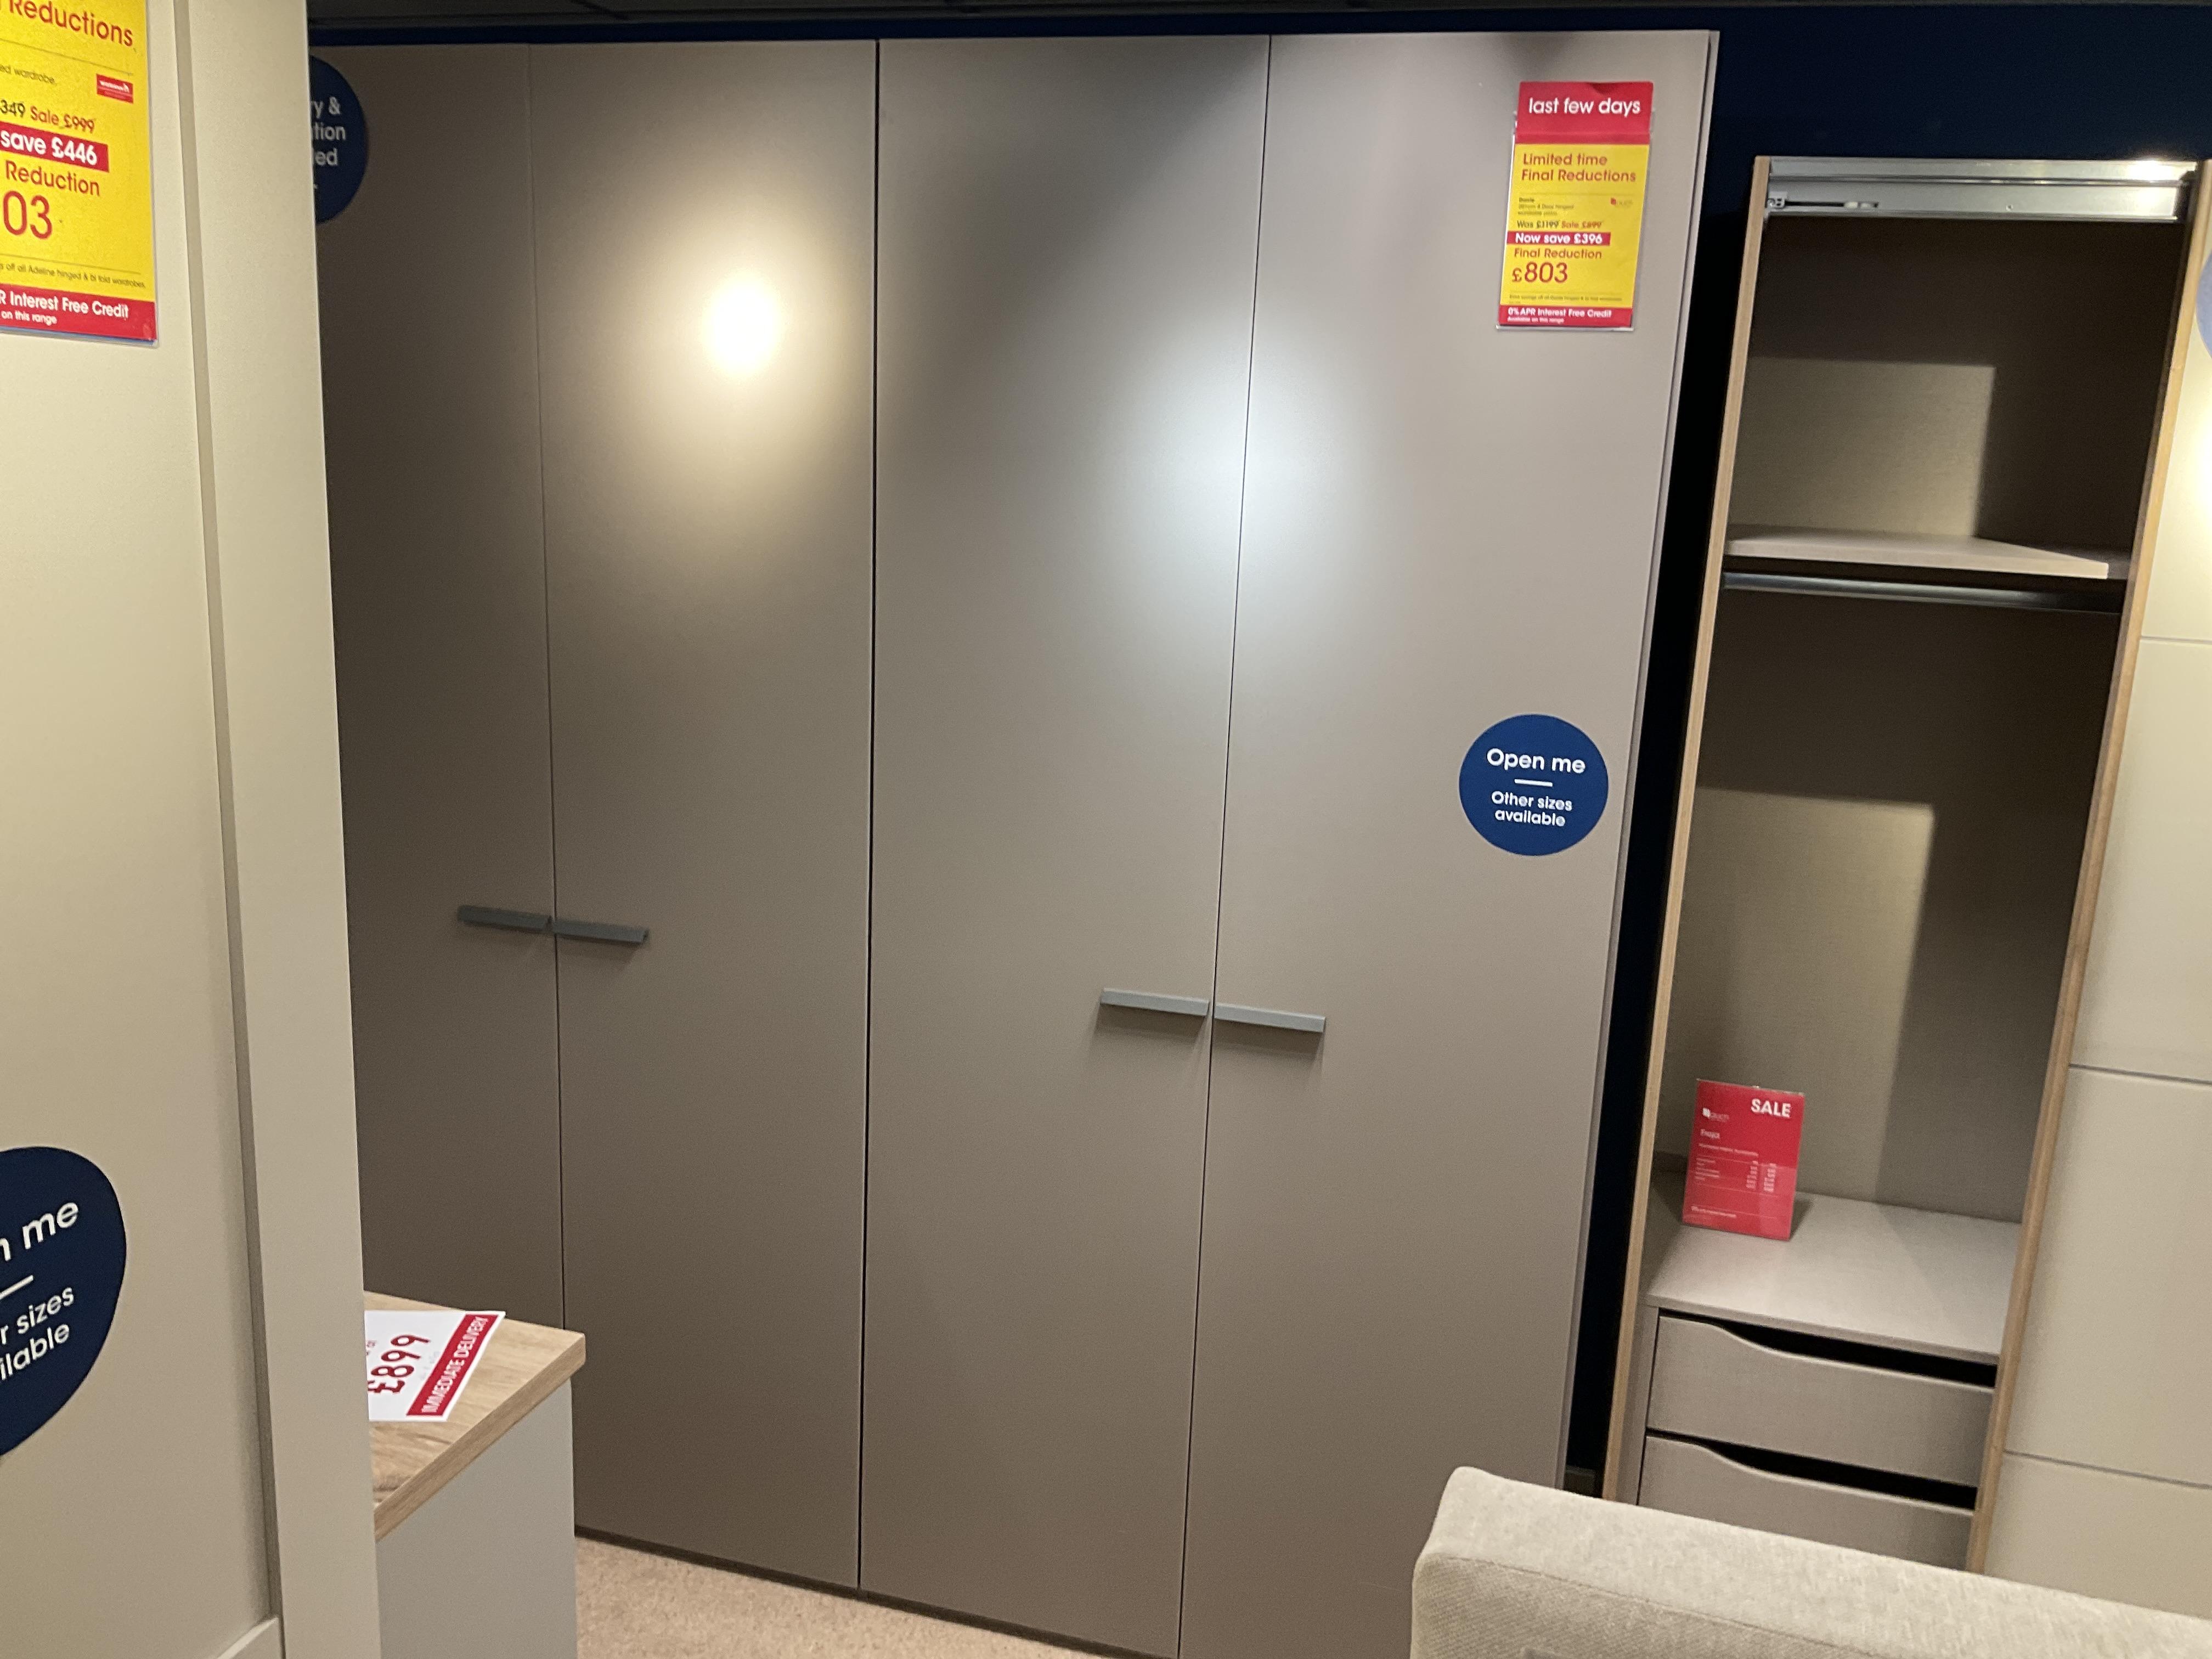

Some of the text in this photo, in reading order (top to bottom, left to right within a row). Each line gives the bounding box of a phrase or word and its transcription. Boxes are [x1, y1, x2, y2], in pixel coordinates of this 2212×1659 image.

[9, 0, 133, 47] Reductions
[1528, 97, 1641, 119] last few days
[30, 105, 59, 126] Sale
[63, 114, 95, 134] £999
[1, 130, 98, 166] save £446
[1523, 153, 1608, 166] Limited time
[5, 159, 100, 197] Reduction
[1521, 169, 1637, 183] Final Reductions
[1517, 221, 1534, 229] Was
[1561, 221, 1579, 229] Sale
[1515, 232, 1603, 245] Now save £396
[1514, 247, 1602, 259] Final Reduction
[1511, 261, 1568, 284] £803
[10, 290, 59, 312] Interest
[62, 297, 89, 314] Free
[92, 300, 129, 319] Credit
[1520, 307, 1536, 316] APR
[1538, 307, 1566, 317] Interest
[1568, 308, 1585, 317] Free
[1587, 309, 1612, 318] Credit
[1, 310, 58, 326] on this range
[1486, 748, 1586, 774] Open me
[1491, 790, 1573, 811] Other sizes
[1494, 809, 1566, 827] available
[1751, 1098, 1792, 1119] SALE
[22, 1202, 78, 1250] me
[16, 1287, 75, 1335] sizes
[421, 1316, 489, 1413] IMMEDIATE DELIVERY
